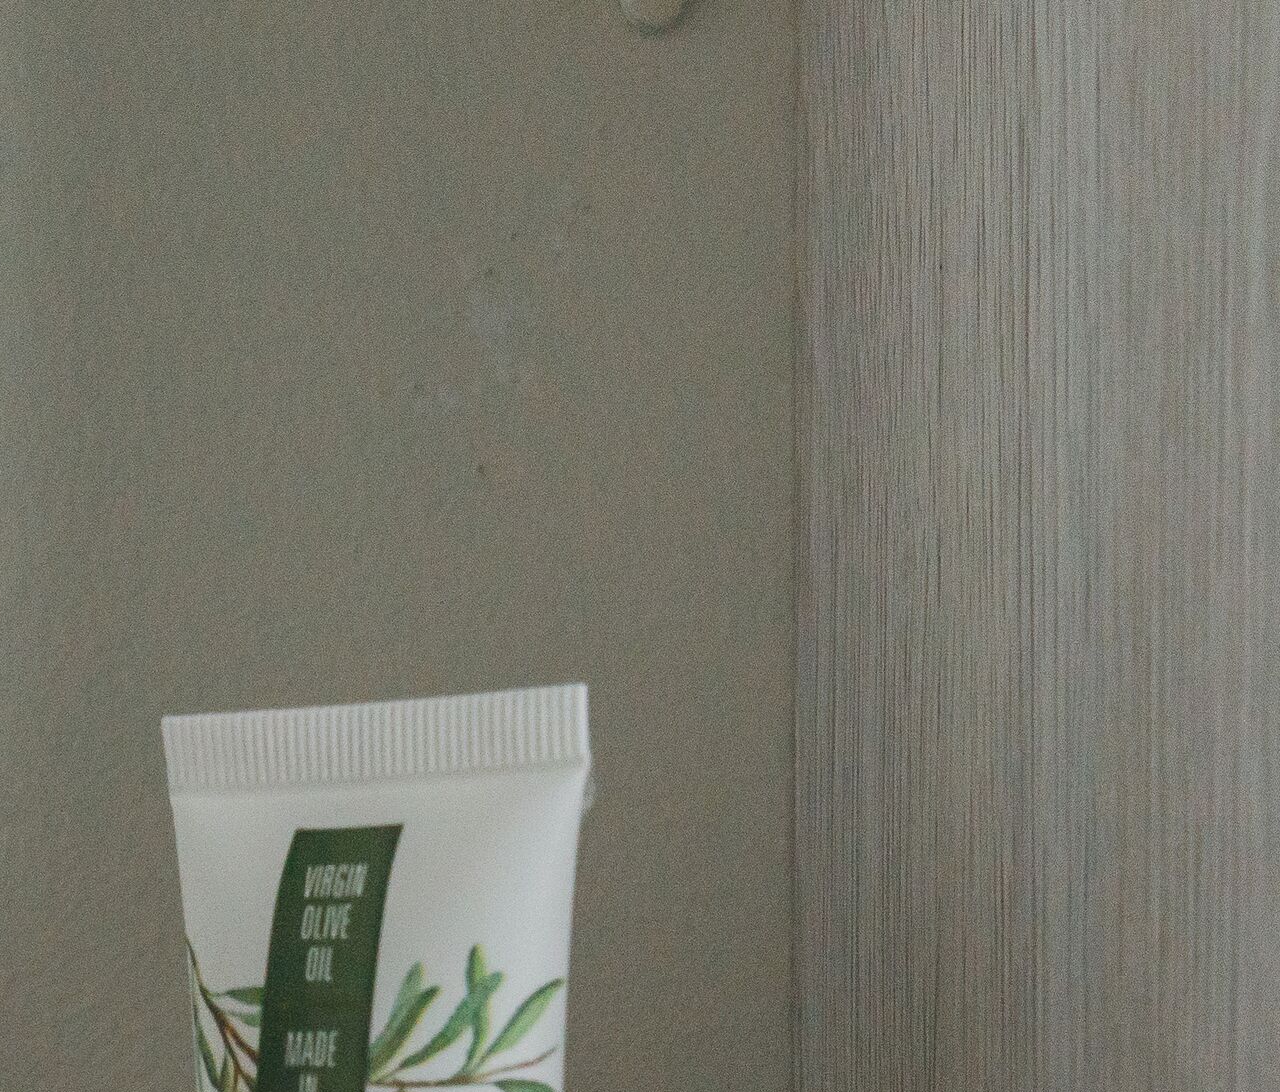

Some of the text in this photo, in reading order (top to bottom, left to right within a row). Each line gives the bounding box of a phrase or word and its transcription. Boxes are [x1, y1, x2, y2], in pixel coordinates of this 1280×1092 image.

[303, 863, 369, 899] VIRGIN
[300, 903, 353, 940] OLIVE
[305, 946, 335, 983] OIL
[285, 1029, 338, 1068] MADE
